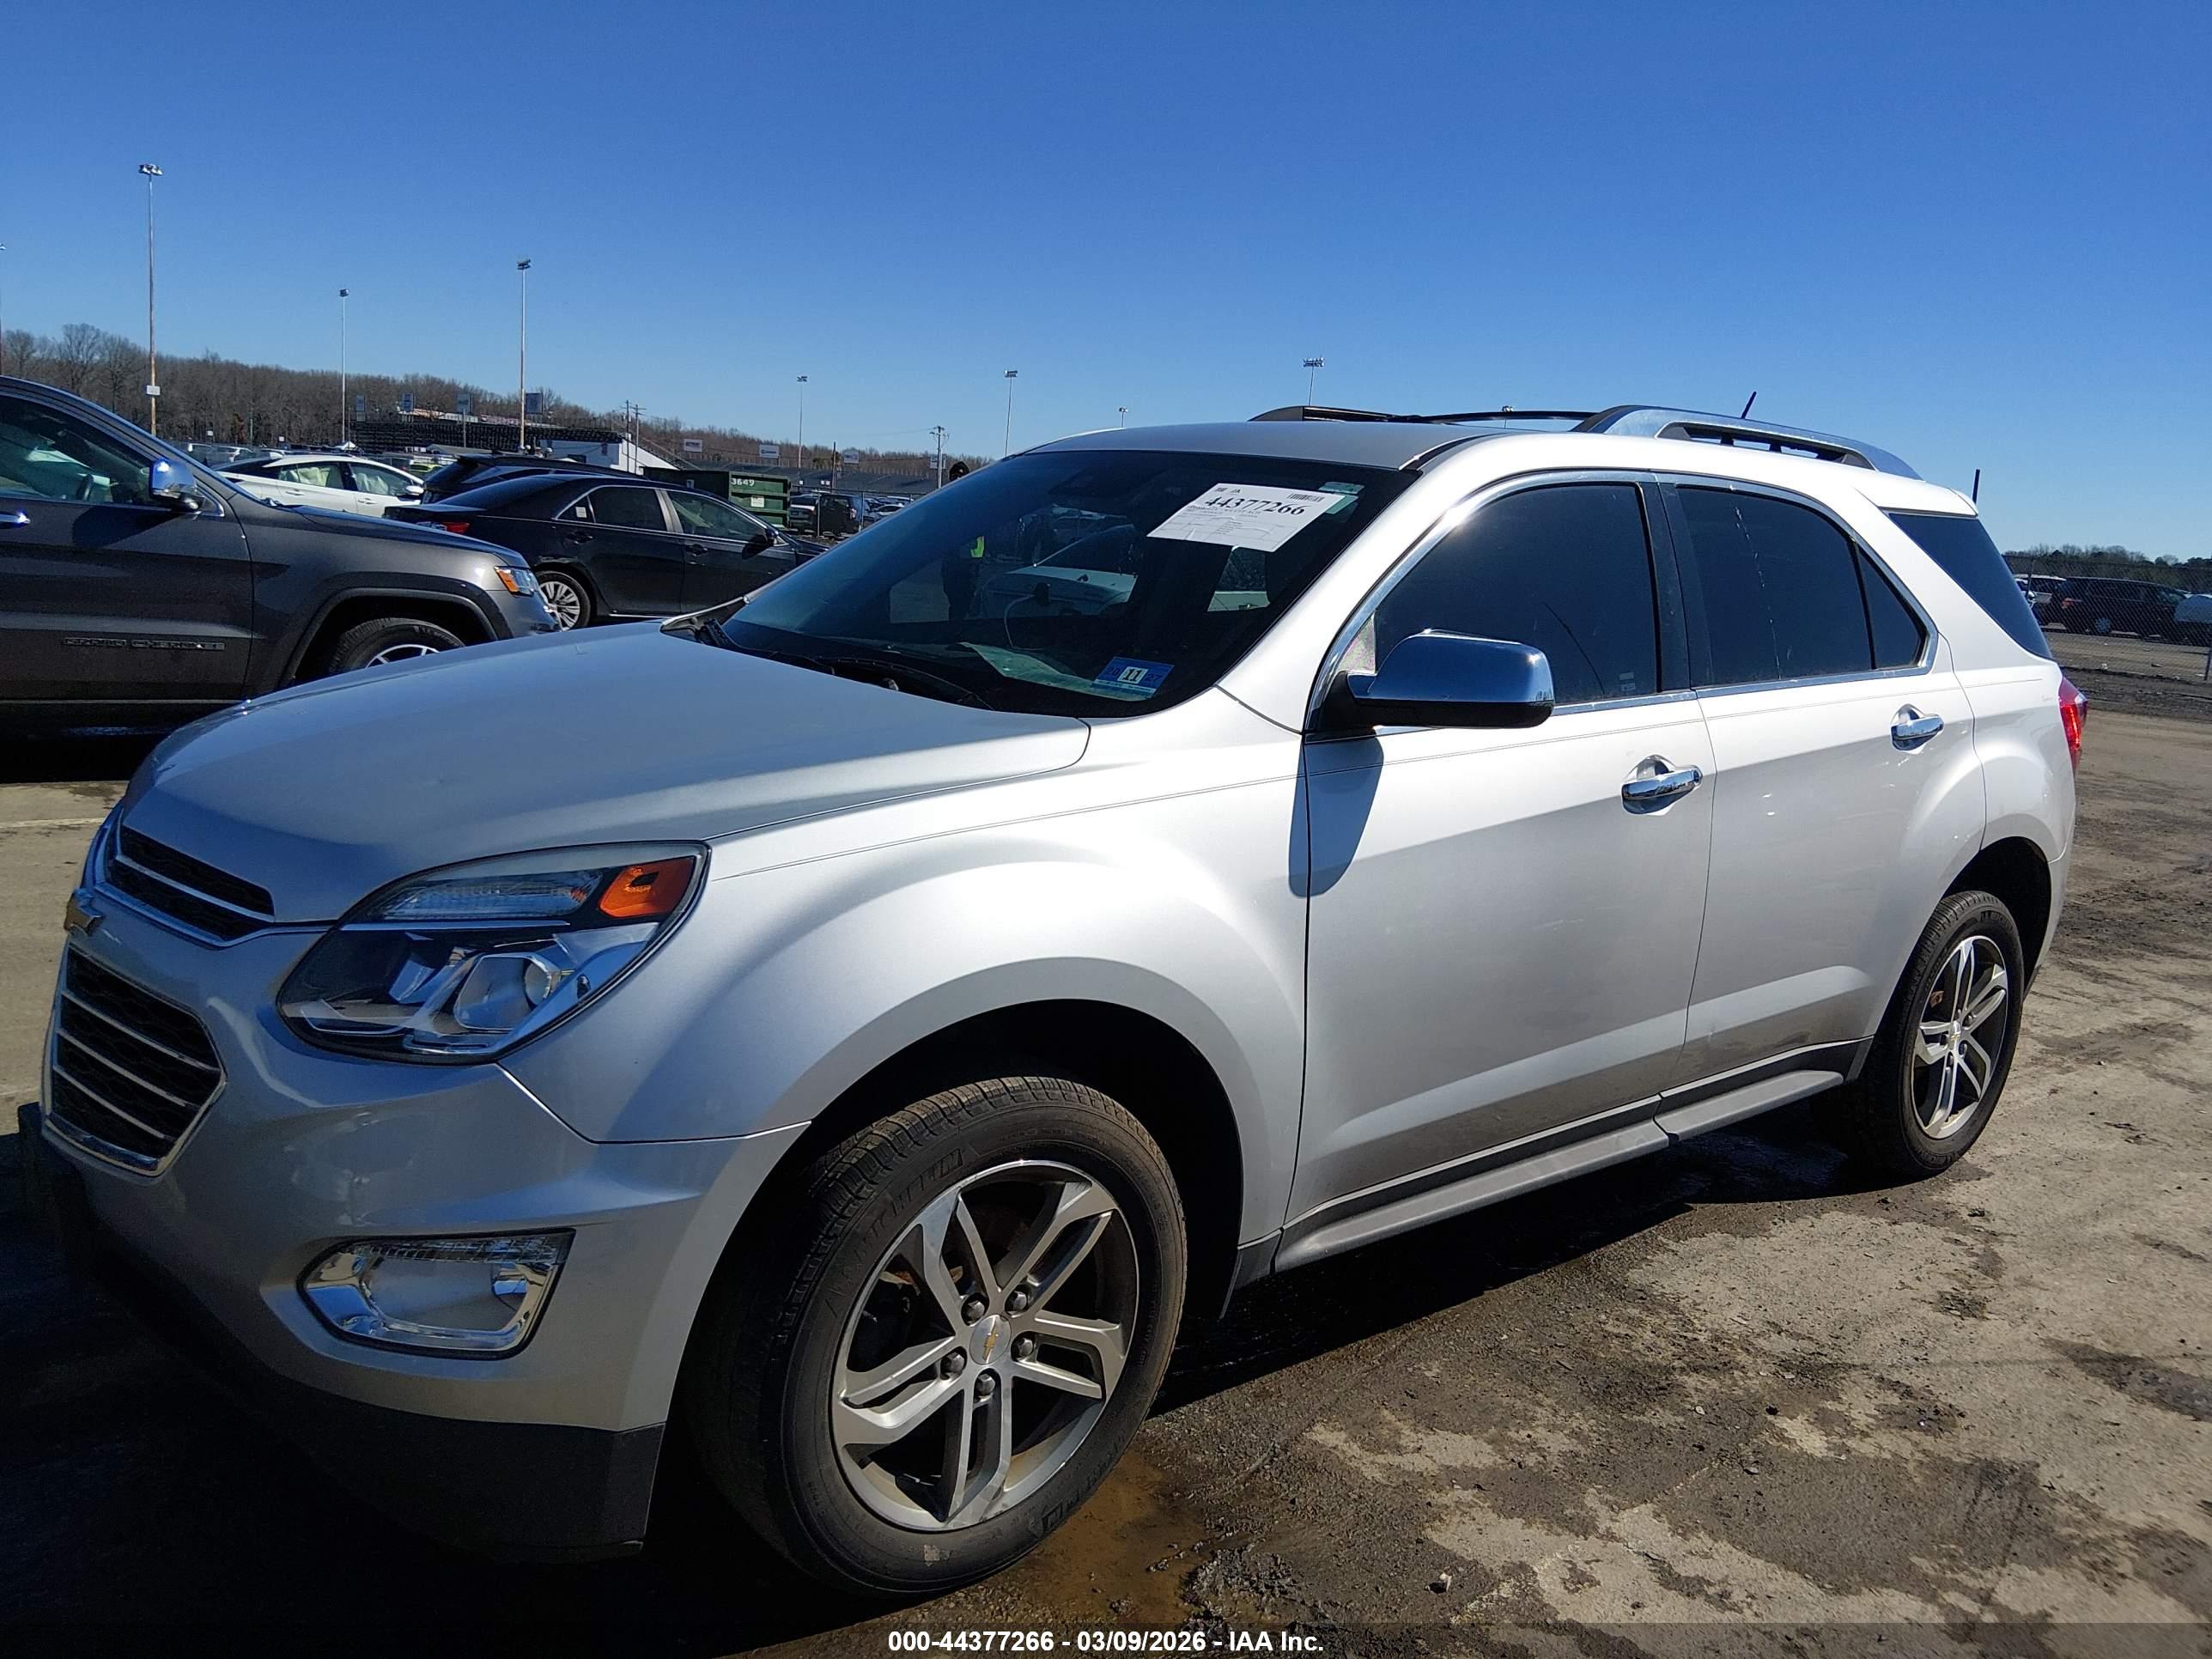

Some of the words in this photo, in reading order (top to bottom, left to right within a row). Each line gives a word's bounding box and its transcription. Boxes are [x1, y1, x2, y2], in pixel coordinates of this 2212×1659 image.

[730, 477, 755, 487] 3649
[1205, 495, 1308, 515] 44377266
[1123, 669, 1141, 681] 11
